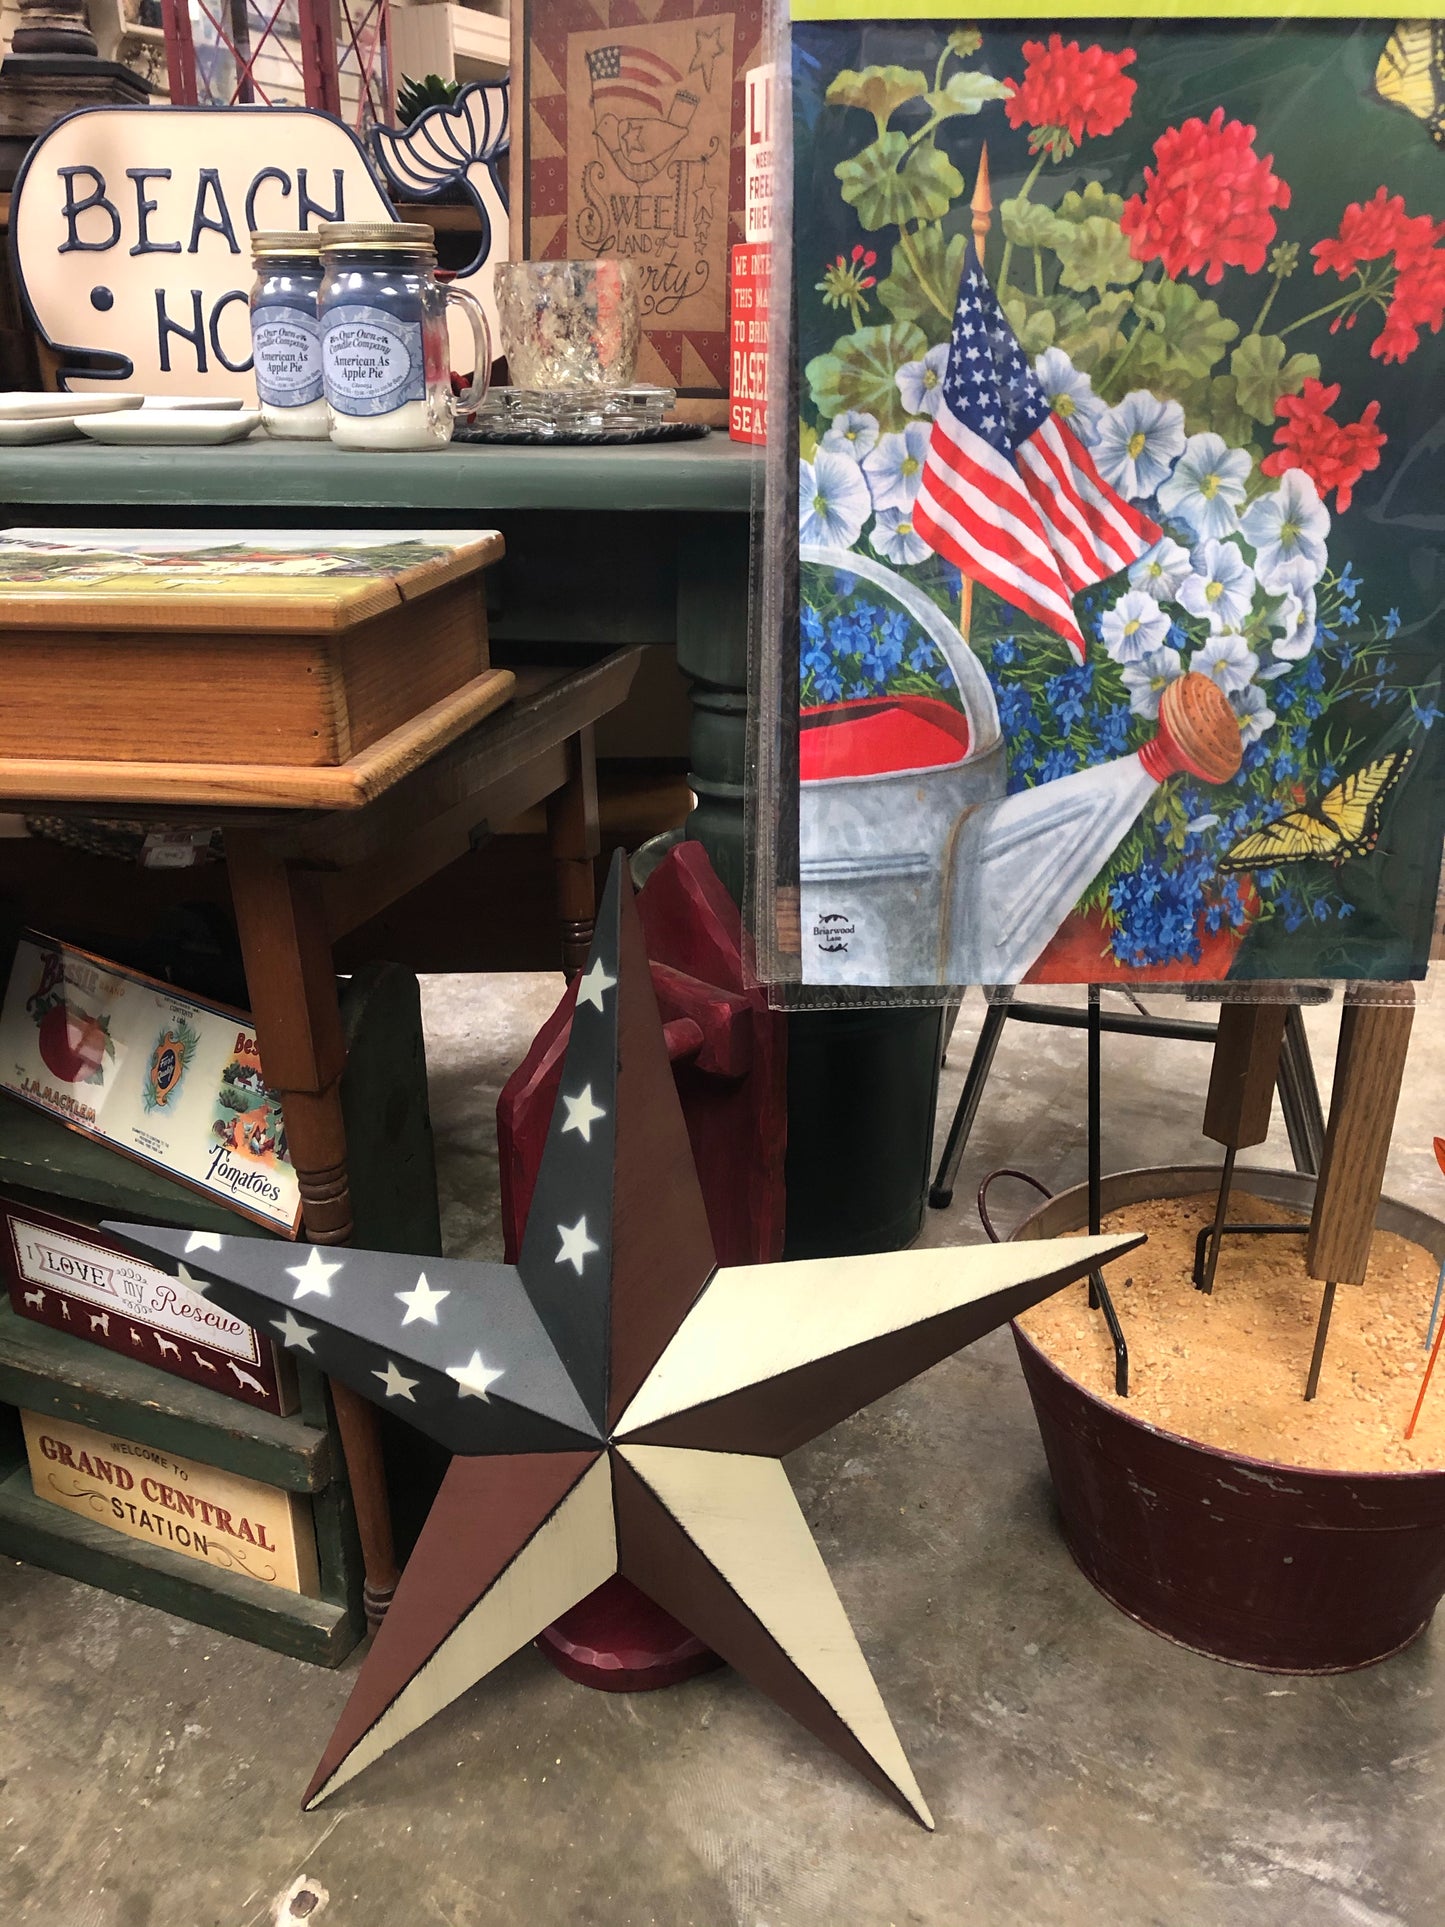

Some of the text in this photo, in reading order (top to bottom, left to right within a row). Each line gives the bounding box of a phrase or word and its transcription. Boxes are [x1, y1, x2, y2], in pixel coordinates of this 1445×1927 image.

[57, 166, 345, 256] BEACH
[576, 160, 709, 244] SWEET
[616, 229, 653, 254] LAND
[735, 255, 748, 276] WE
[734, 288, 753, 308] THIS
[264, 328, 296, 339] Our Own
[339, 329, 377, 340] Our Own
[734, 320, 746, 342] TO
[275, 337, 310, 352] Company
[329, 338, 391, 355] Candle Company
[261, 350, 308, 362] American As
[334, 354, 390, 367] American As
[267, 361, 303, 375] Apple Pie
[341, 366, 384, 381] Apple Pie
[813, 924, 855, 936] Briarwood
[204, 1144, 281, 1201] Tomatoes
[26, 1245, 244, 1336] I LOVE my Rescue
[111, 1442, 188, 1482] WELCOME TO
[39, 1435, 276, 1552] GRAND CENTRAL
[111, 1496, 209, 1556] STATION
